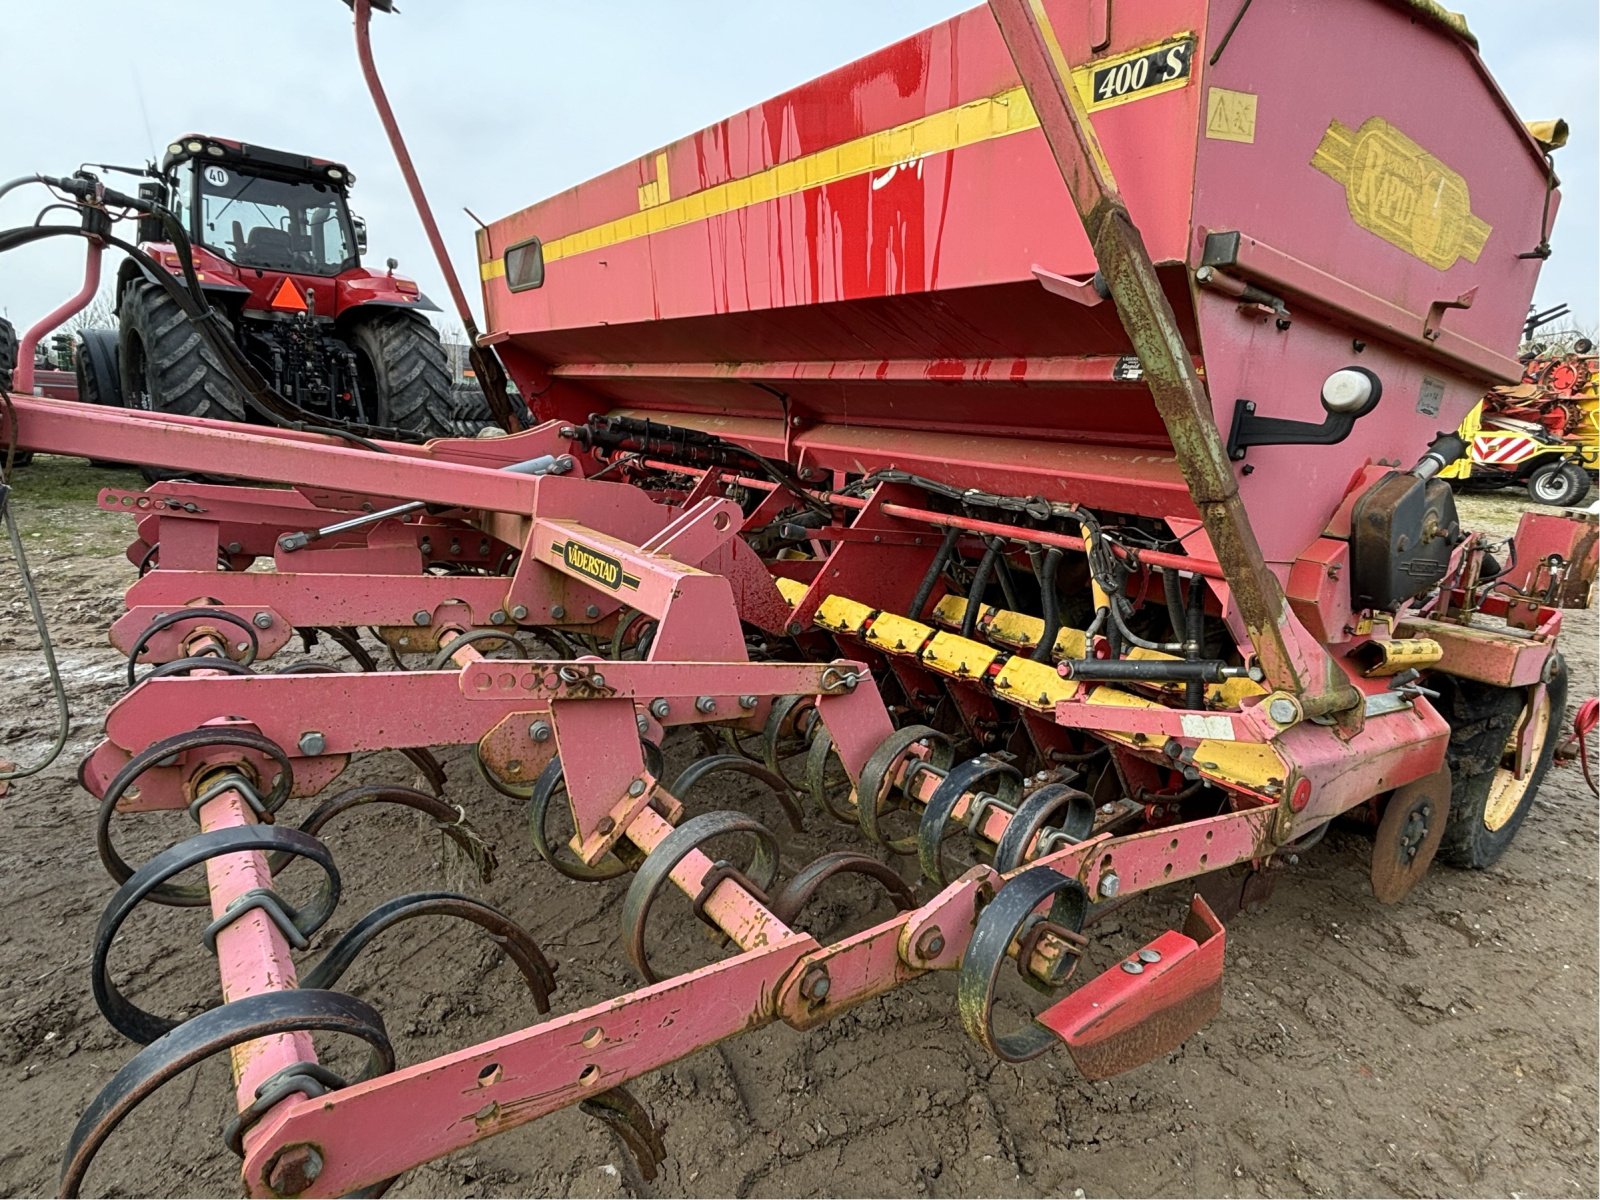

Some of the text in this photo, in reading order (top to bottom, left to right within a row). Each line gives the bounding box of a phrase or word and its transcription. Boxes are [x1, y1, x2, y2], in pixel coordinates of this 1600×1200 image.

[1098, 44, 1186, 99] 400 S
[209, 169, 225, 183] 40
[568, 545, 617, 583] VÄDERSTAD
